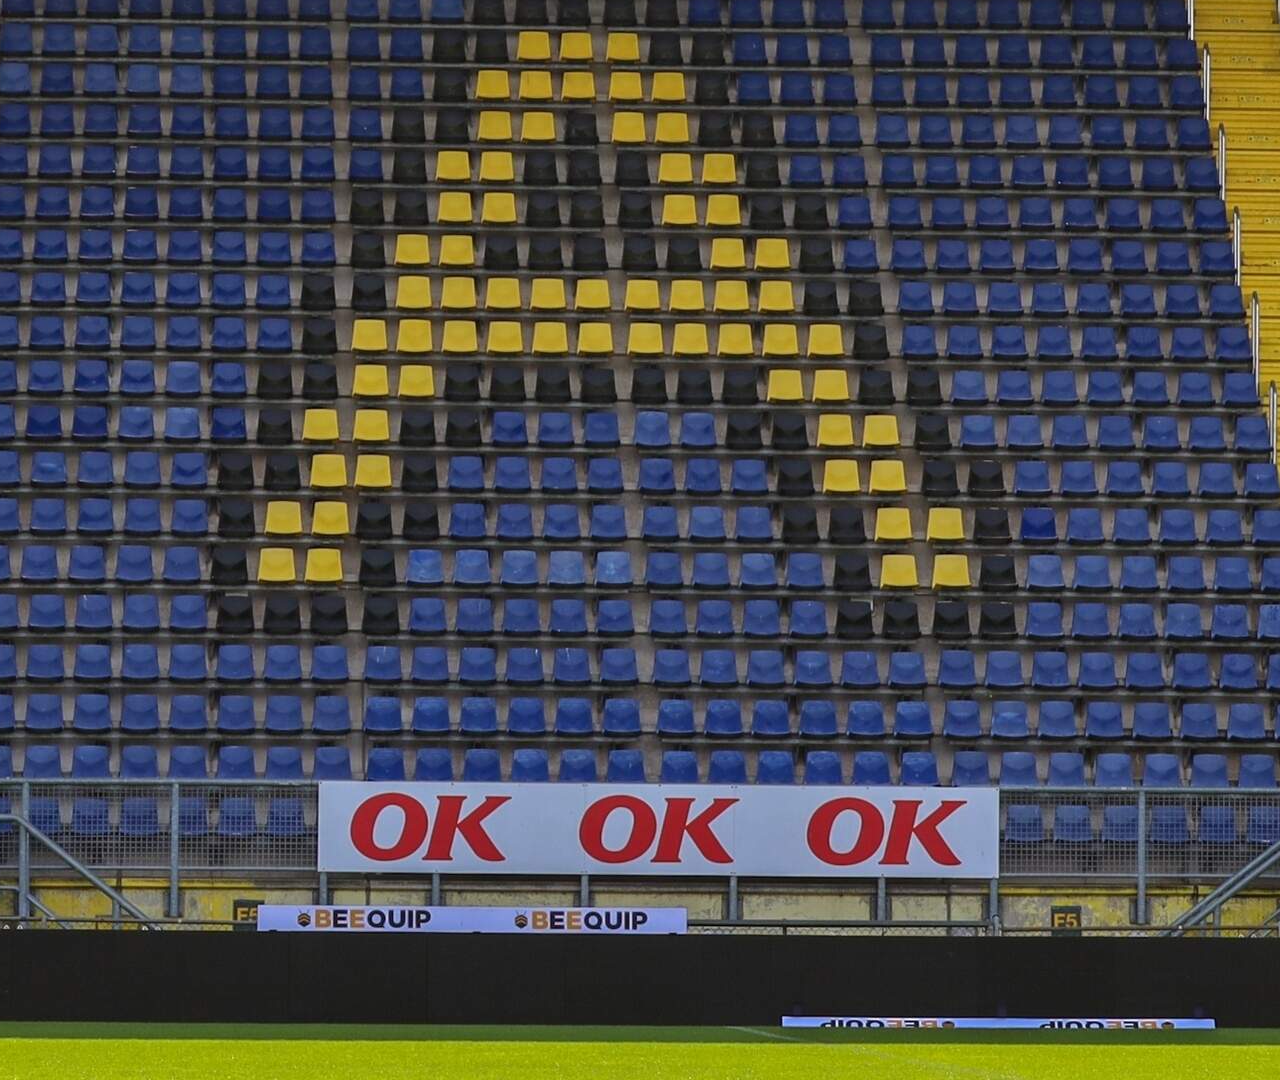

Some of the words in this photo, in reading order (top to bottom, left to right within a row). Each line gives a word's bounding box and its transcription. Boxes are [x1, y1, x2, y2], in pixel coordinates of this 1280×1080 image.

[349, 791, 513, 862] OK
[578, 794, 740, 864] OK
[806, 796, 967, 867] OK
[315, 909, 432, 929] BEEQUIP
[532, 910, 649, 930] BEEQUIP
